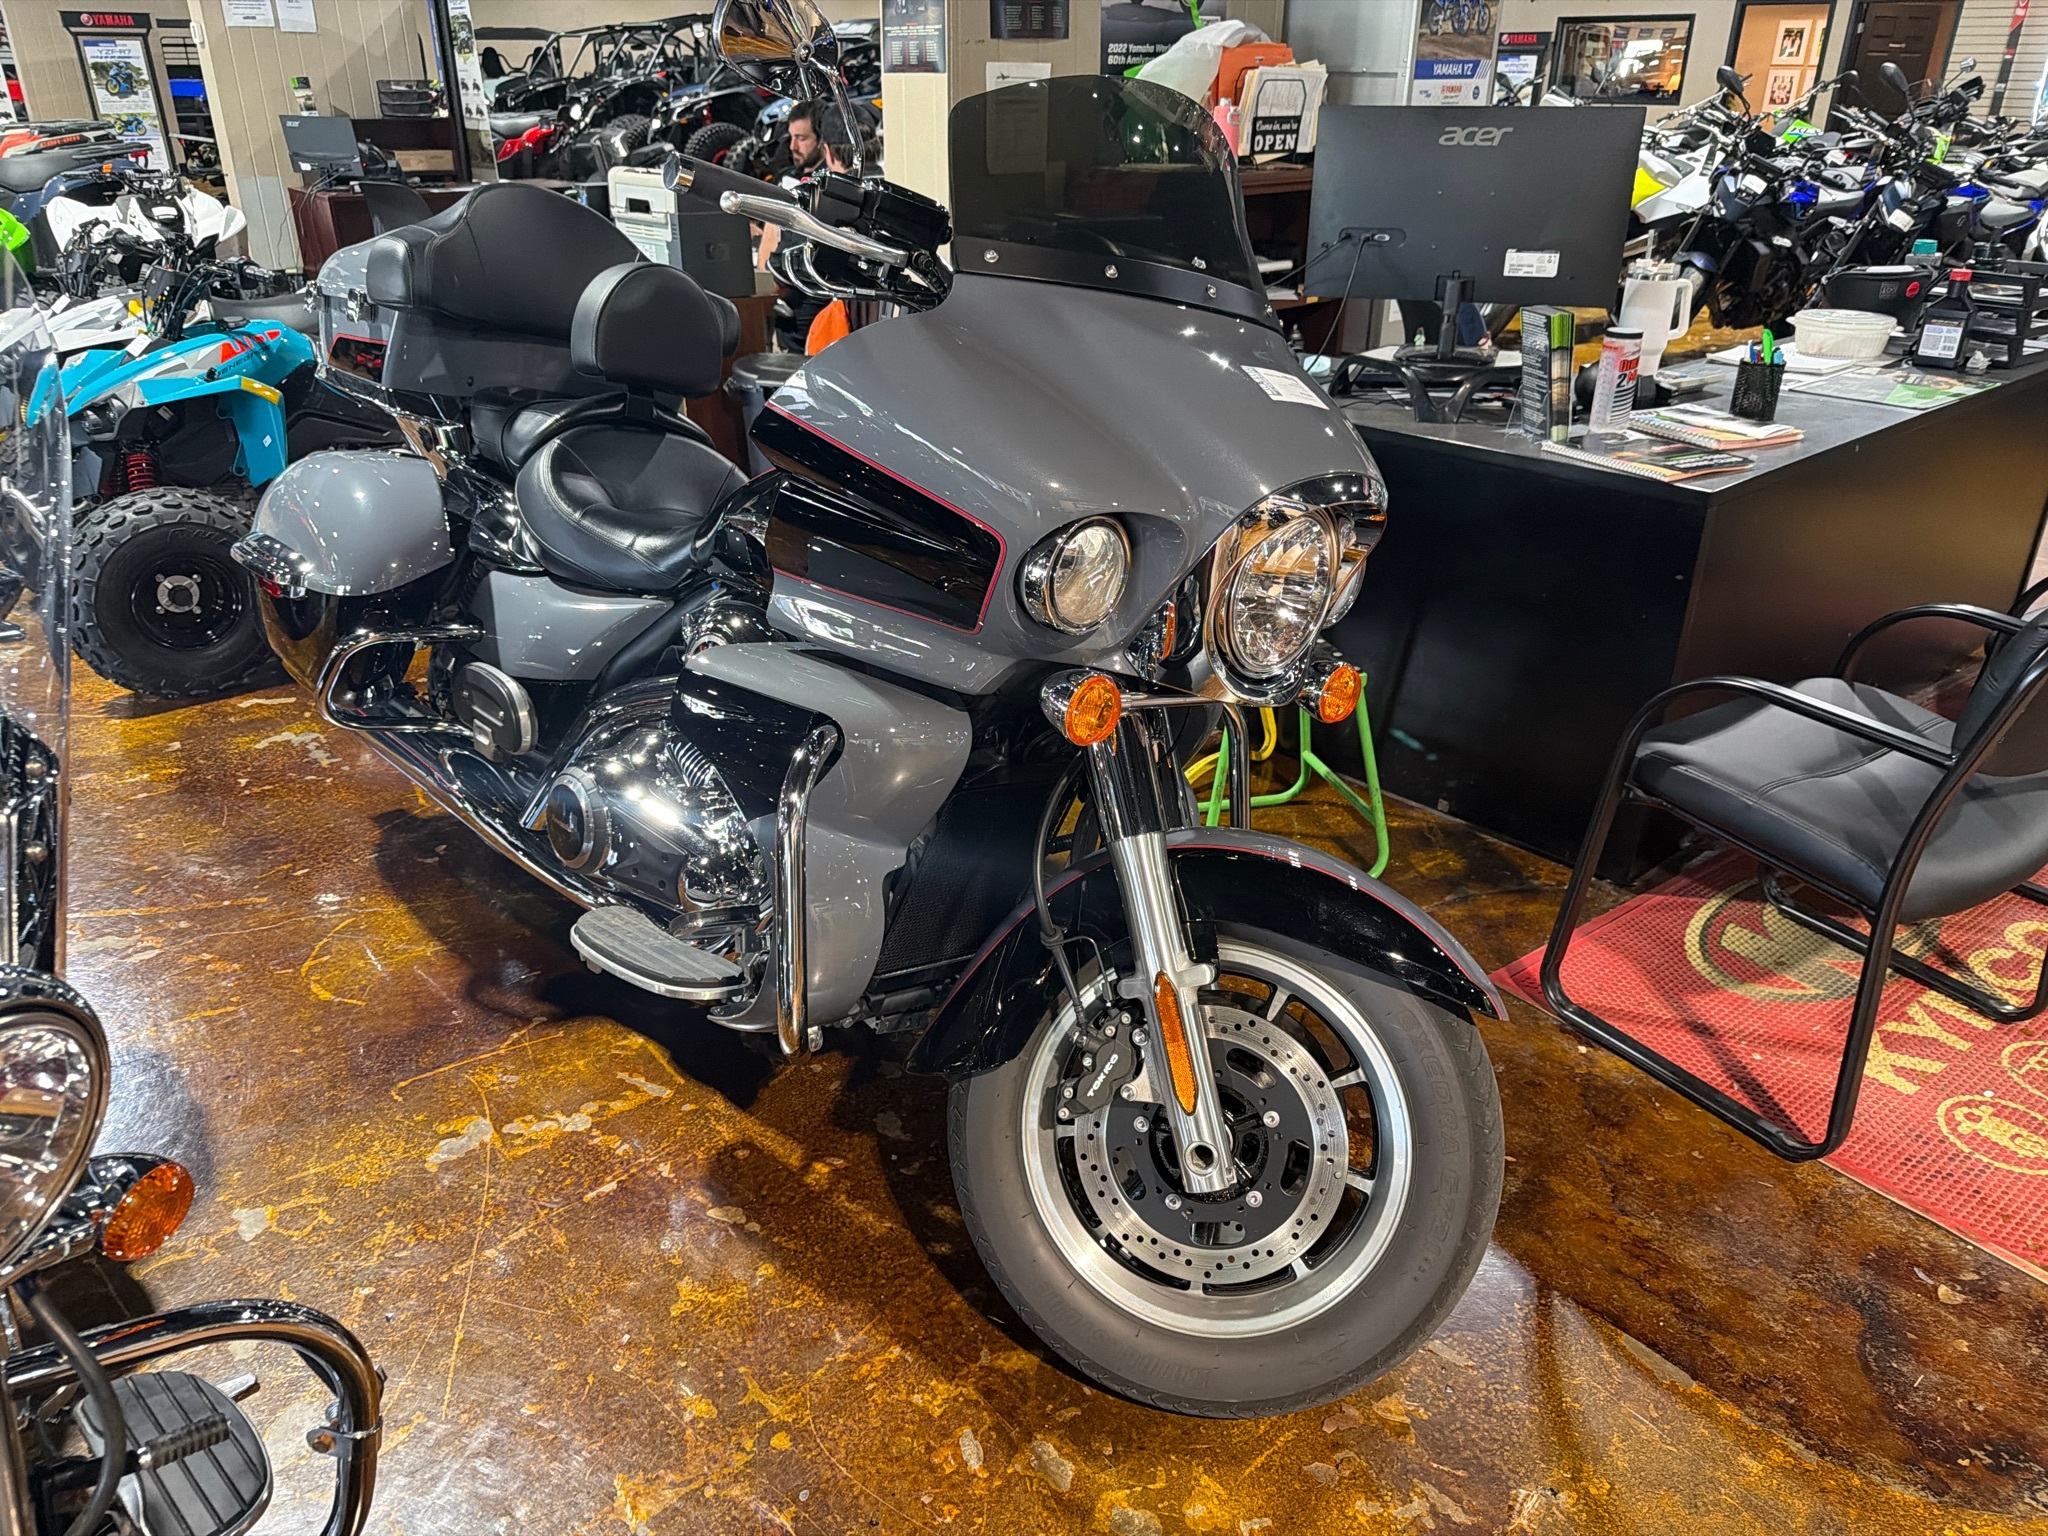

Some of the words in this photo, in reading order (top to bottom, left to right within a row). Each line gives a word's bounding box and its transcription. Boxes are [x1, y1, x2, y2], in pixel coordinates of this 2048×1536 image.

[93, 15, 135, 25] YAMAHA
[1510, 34, 1537, 43] YAMAHA
[1107, 43, 1128, 53] 2022
[1129, 43, 1155, 53] Yamaha
[1156, 43, 1171, 53] Worl
[1107, 55, 1126, 65] 60th
[1433, 63, 1463, 75] YAMAHA
[1463, 63, 1474, 74] YZ
[1256, 120, 1273, 130] Come
[1254, 133, 1297, 151] OPEN
[1438, 127, 1514, 147] acer
[1087, 1054, 1119, 1097] TOKICO
